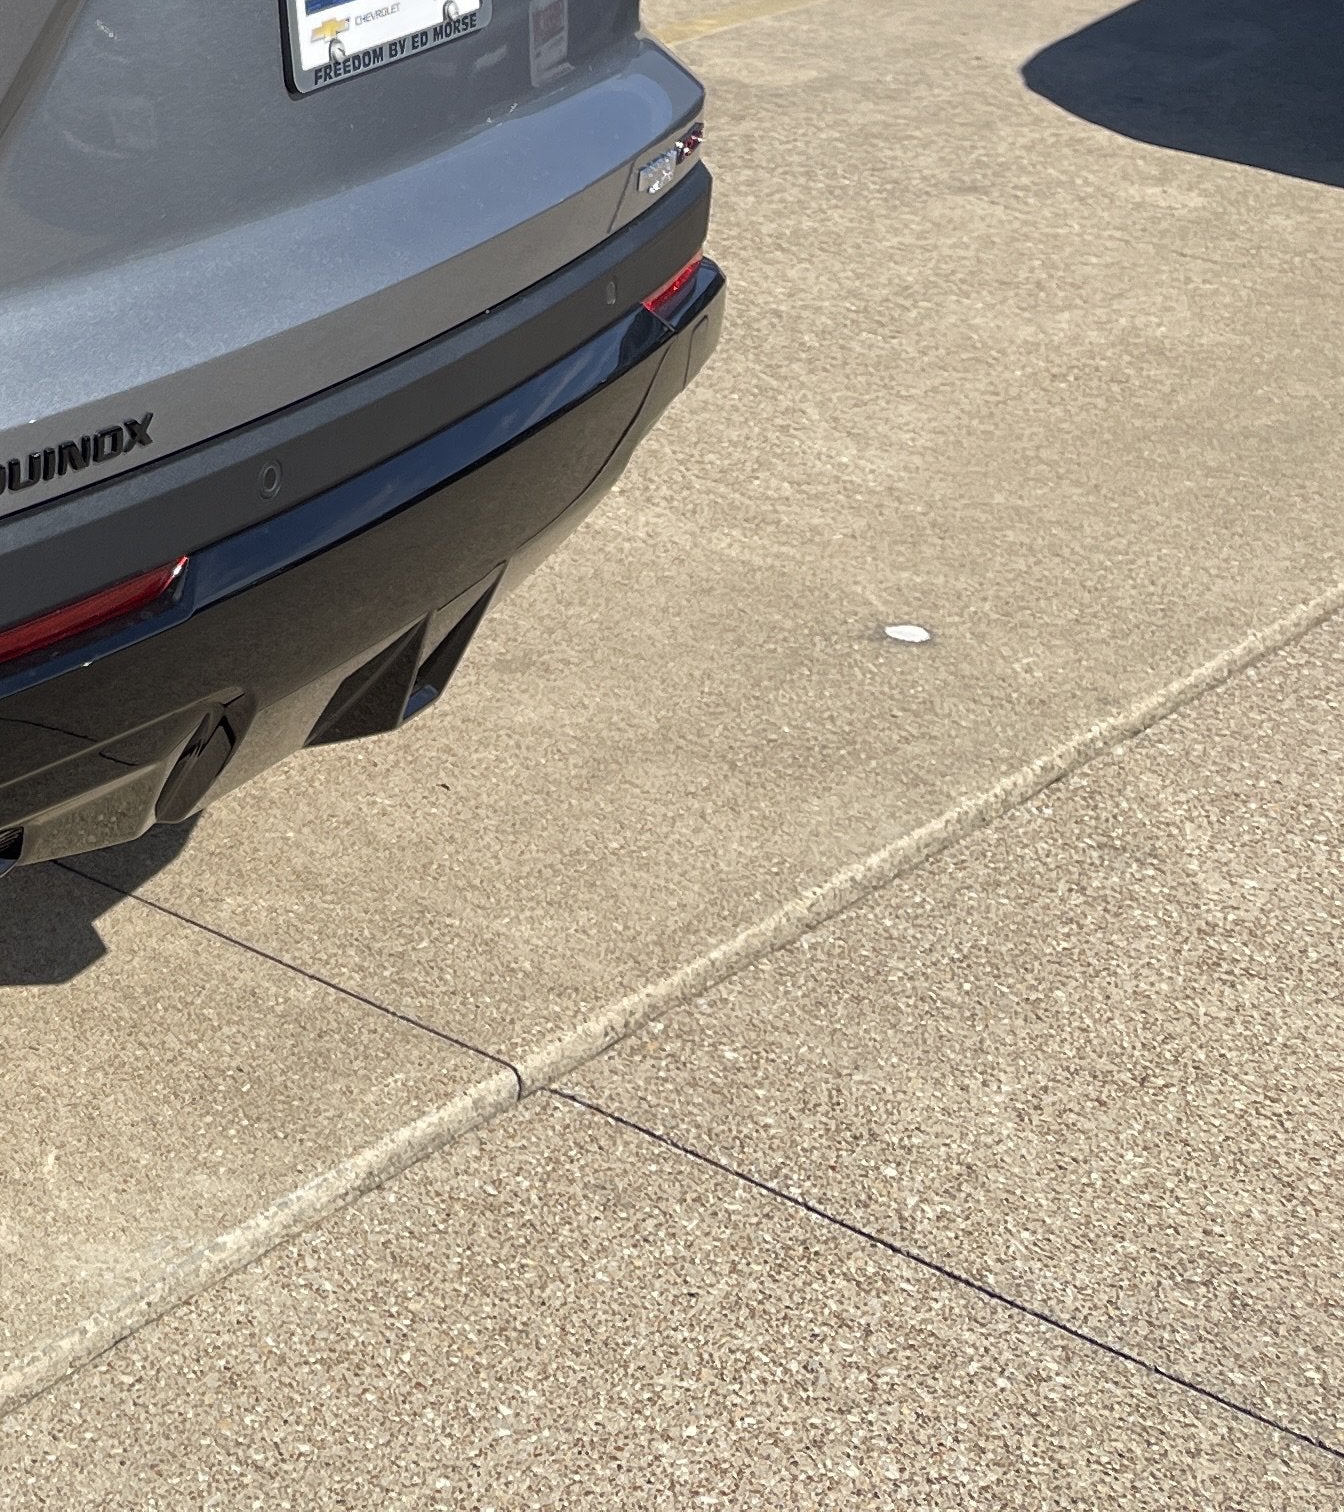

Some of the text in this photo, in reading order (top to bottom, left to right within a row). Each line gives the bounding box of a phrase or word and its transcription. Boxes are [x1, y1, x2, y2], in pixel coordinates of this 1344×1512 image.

[355, 2, 401, 26] CHEVROLET
[314, 12, 477, 85] FREEDOM BY ED MORSE
